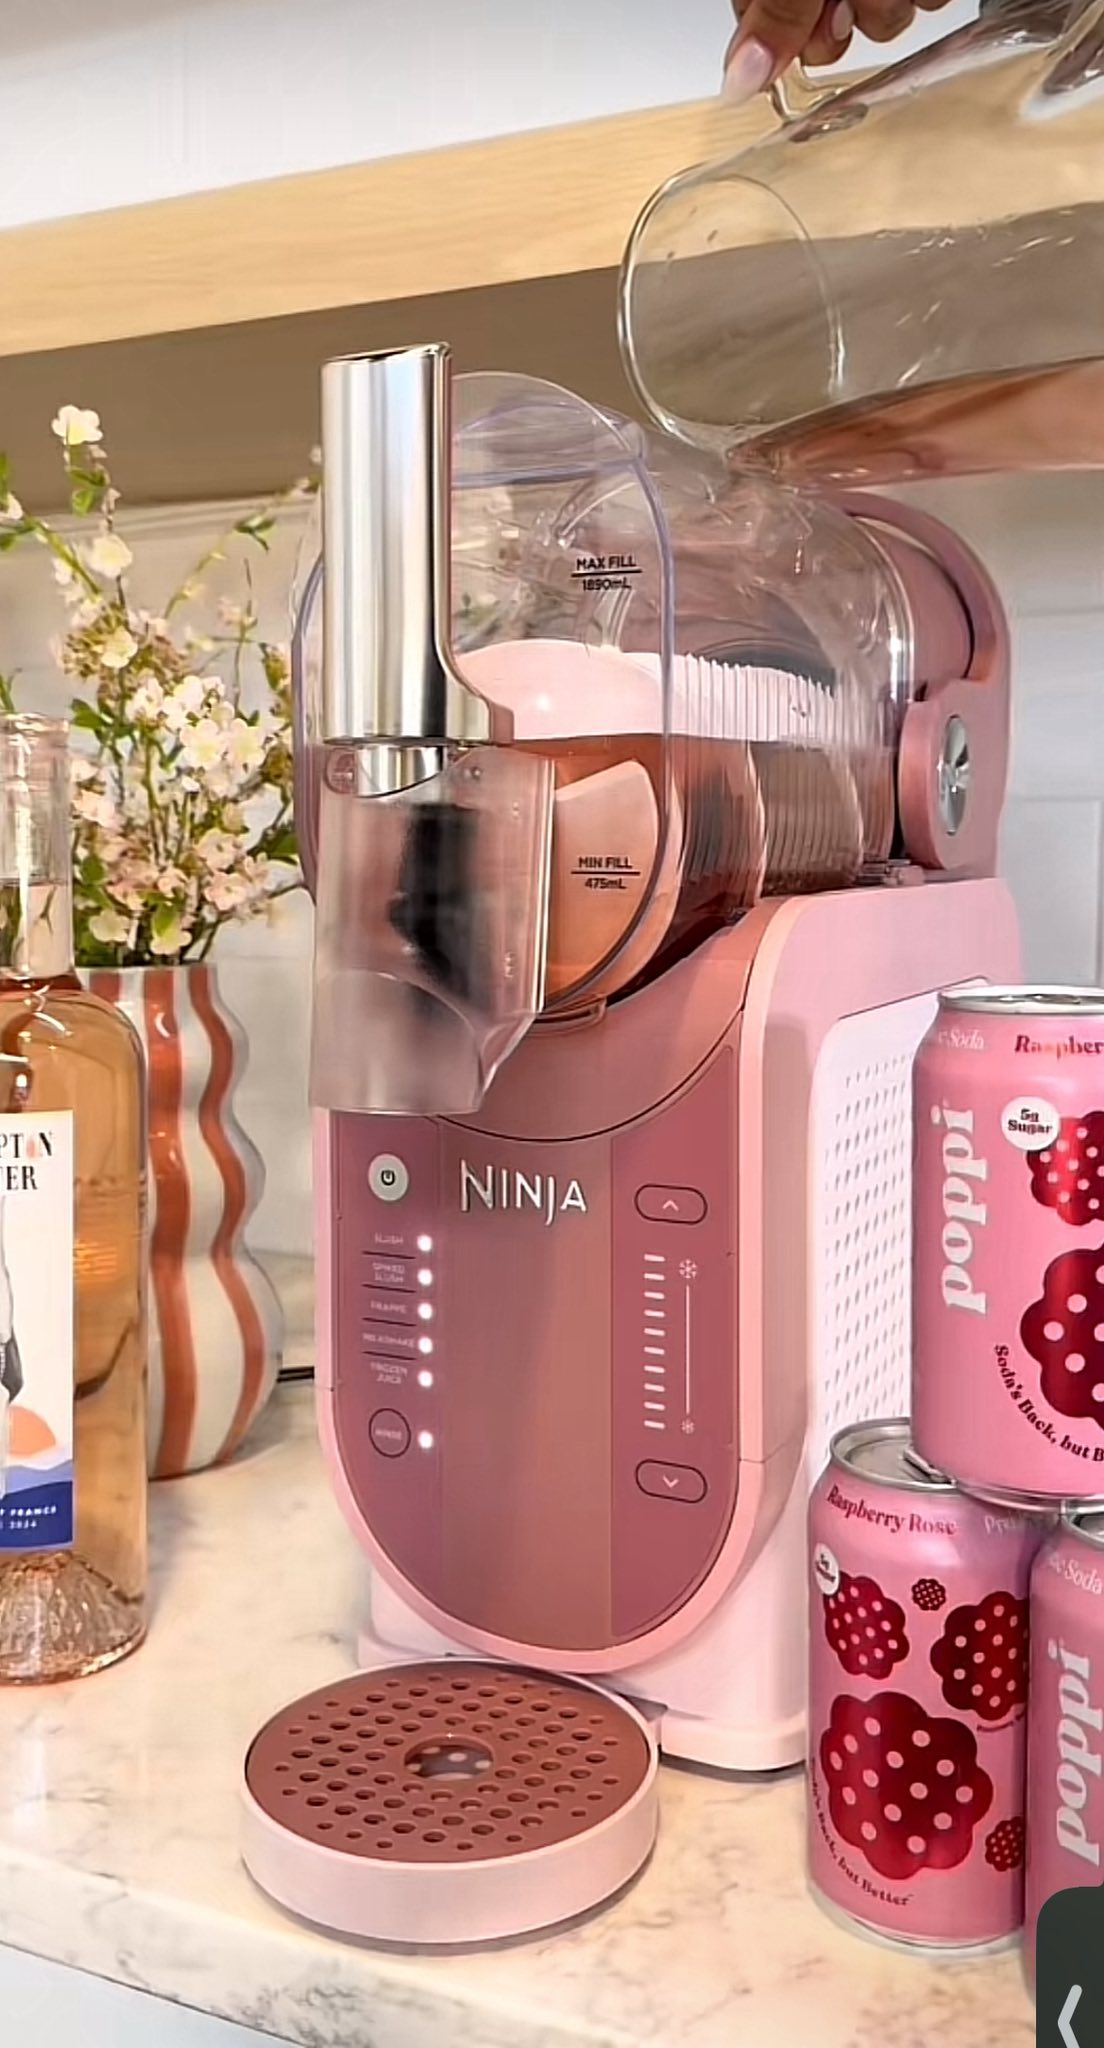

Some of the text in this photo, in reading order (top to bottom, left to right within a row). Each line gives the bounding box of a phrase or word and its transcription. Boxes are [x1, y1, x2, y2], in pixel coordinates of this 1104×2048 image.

[577, 555, 636, 570] MAX FILL
[579, 856, 632, 869] MIN FILL
[585, 877, 627, 890] 475mL
[948, 1027, 984, 1049] Soda
[1008, 1119, 1053, 1135] Sugar
[1020, 1108, 1039, 1122] 5g
[0, 1165, 38, 1190] ER
[460, 1159, 587, 1226] NINJA
[930, 1098, 987, 1315] poppi
[994, 1344, 1024, 1400] Soda's
[1018, 1398, 1057, 1444] Back,
[1060, 1435, 1091, 1459] but
[827, 1484, 905, 1533] Raspberry
[909, 1513, 957, 1535] Rose
[1064, 1559, 1103, 1595] Soda
[1048, 1637, 1104, 1867] poppi
